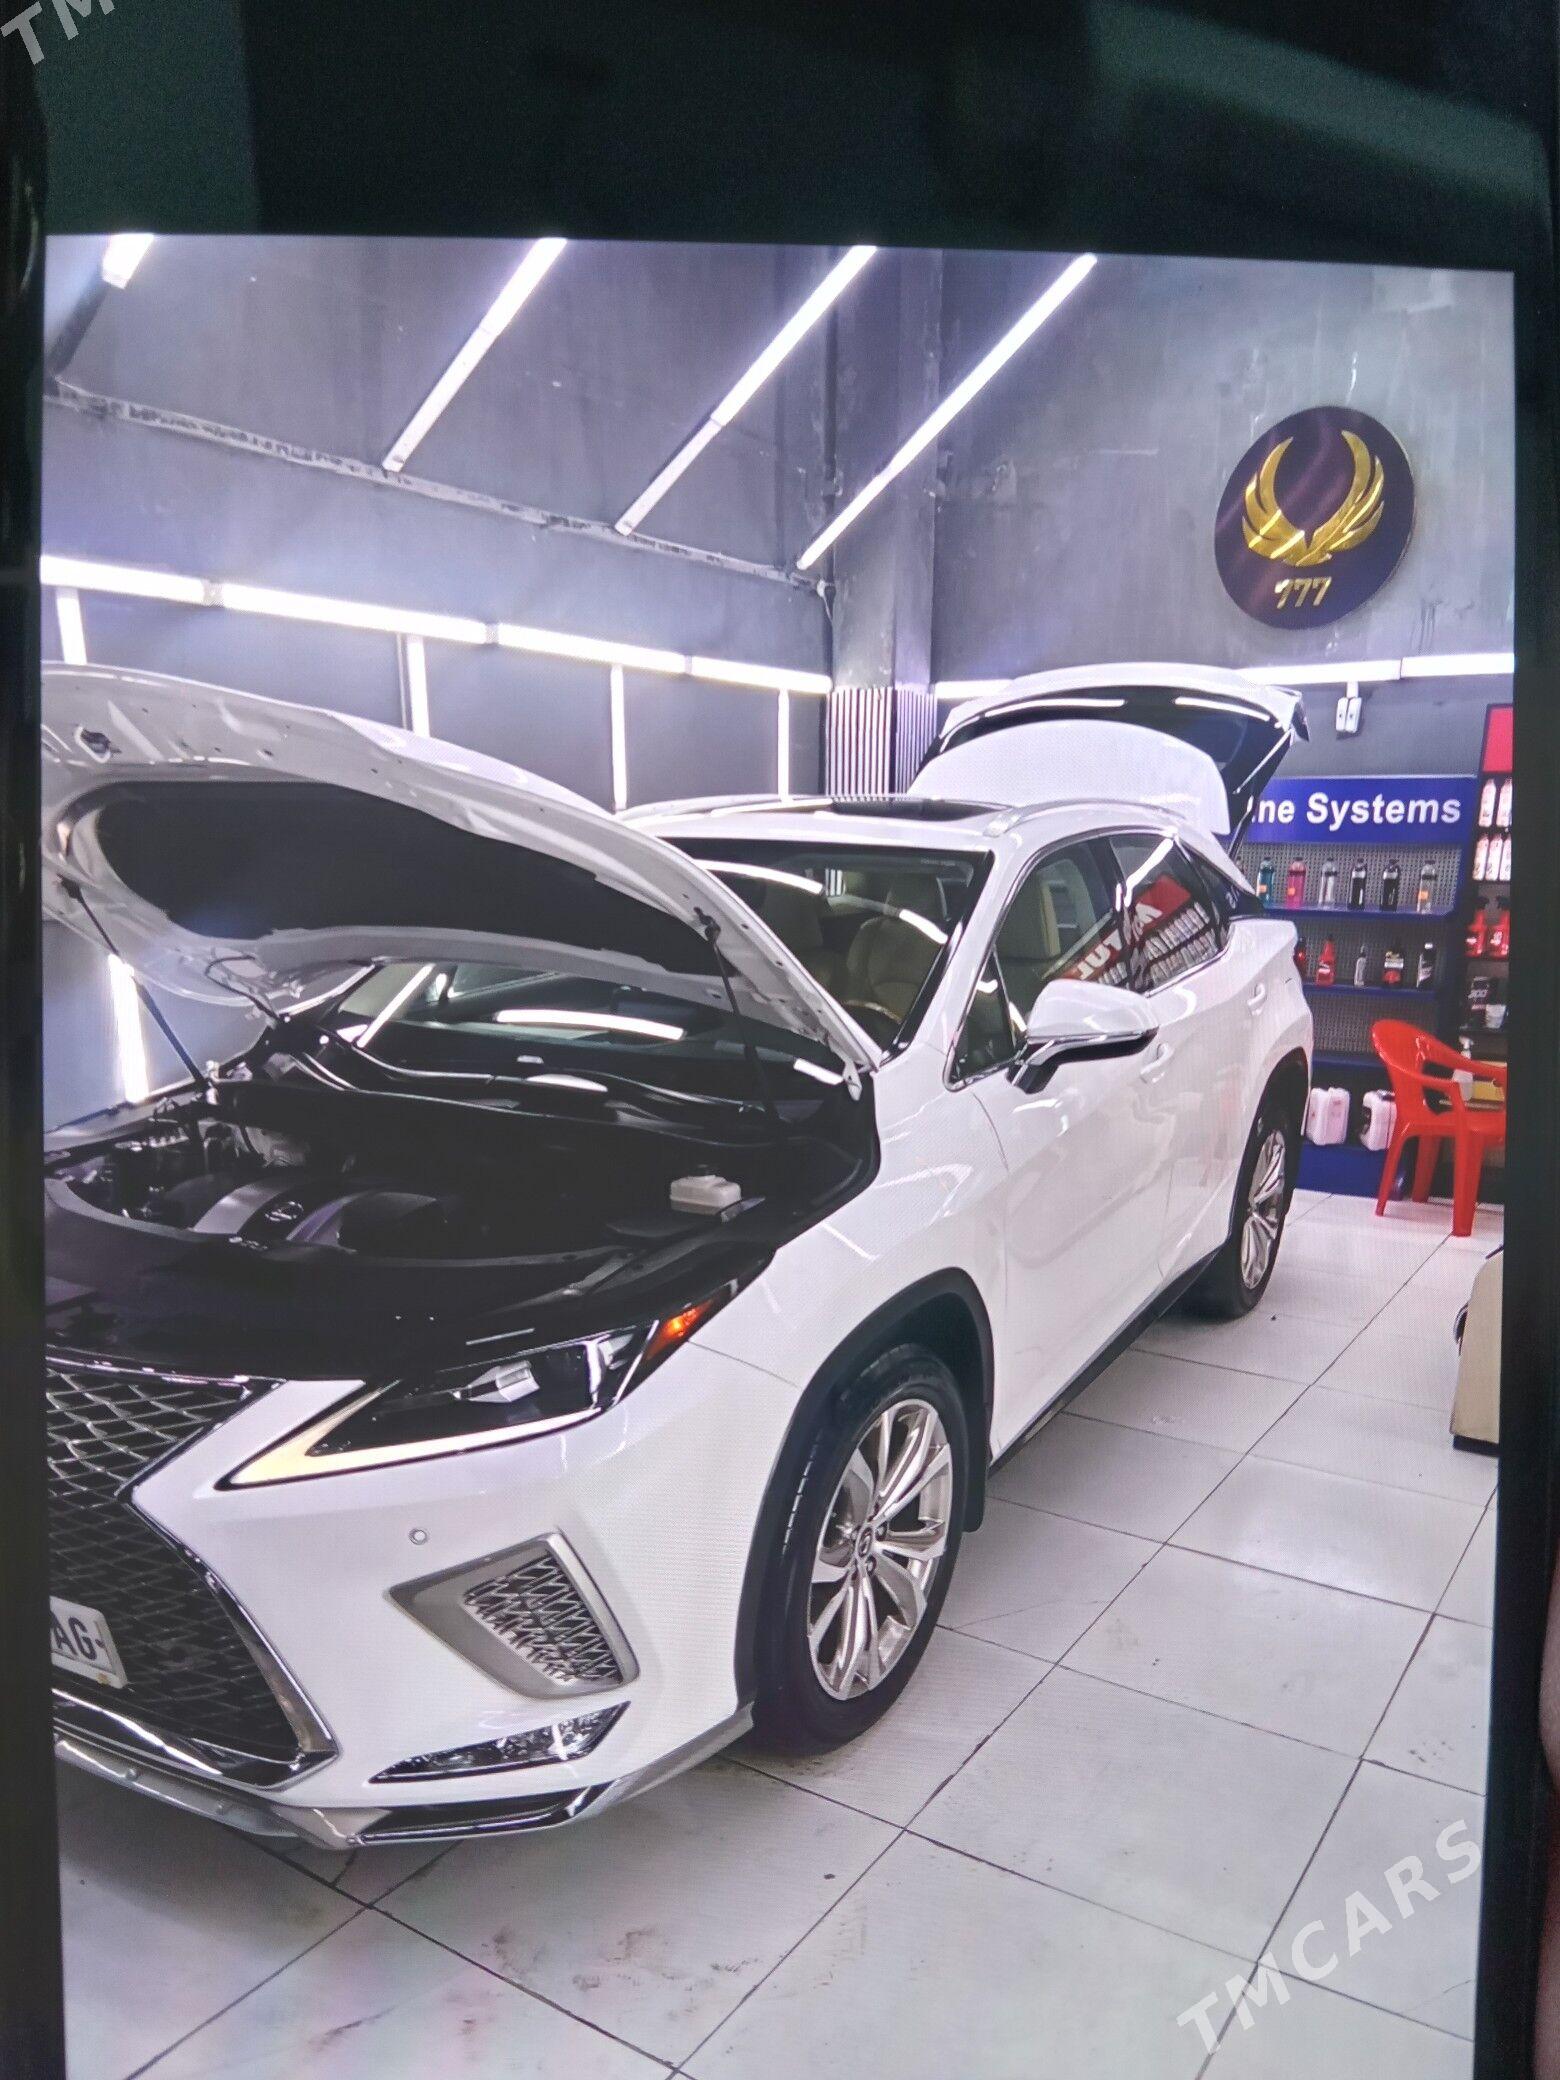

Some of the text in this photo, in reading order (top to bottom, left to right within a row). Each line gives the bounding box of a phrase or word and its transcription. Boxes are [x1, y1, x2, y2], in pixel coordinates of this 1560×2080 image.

[1274, 576, 1332, 609] 777
[1251, 791, 1462, 832] ne Systems
